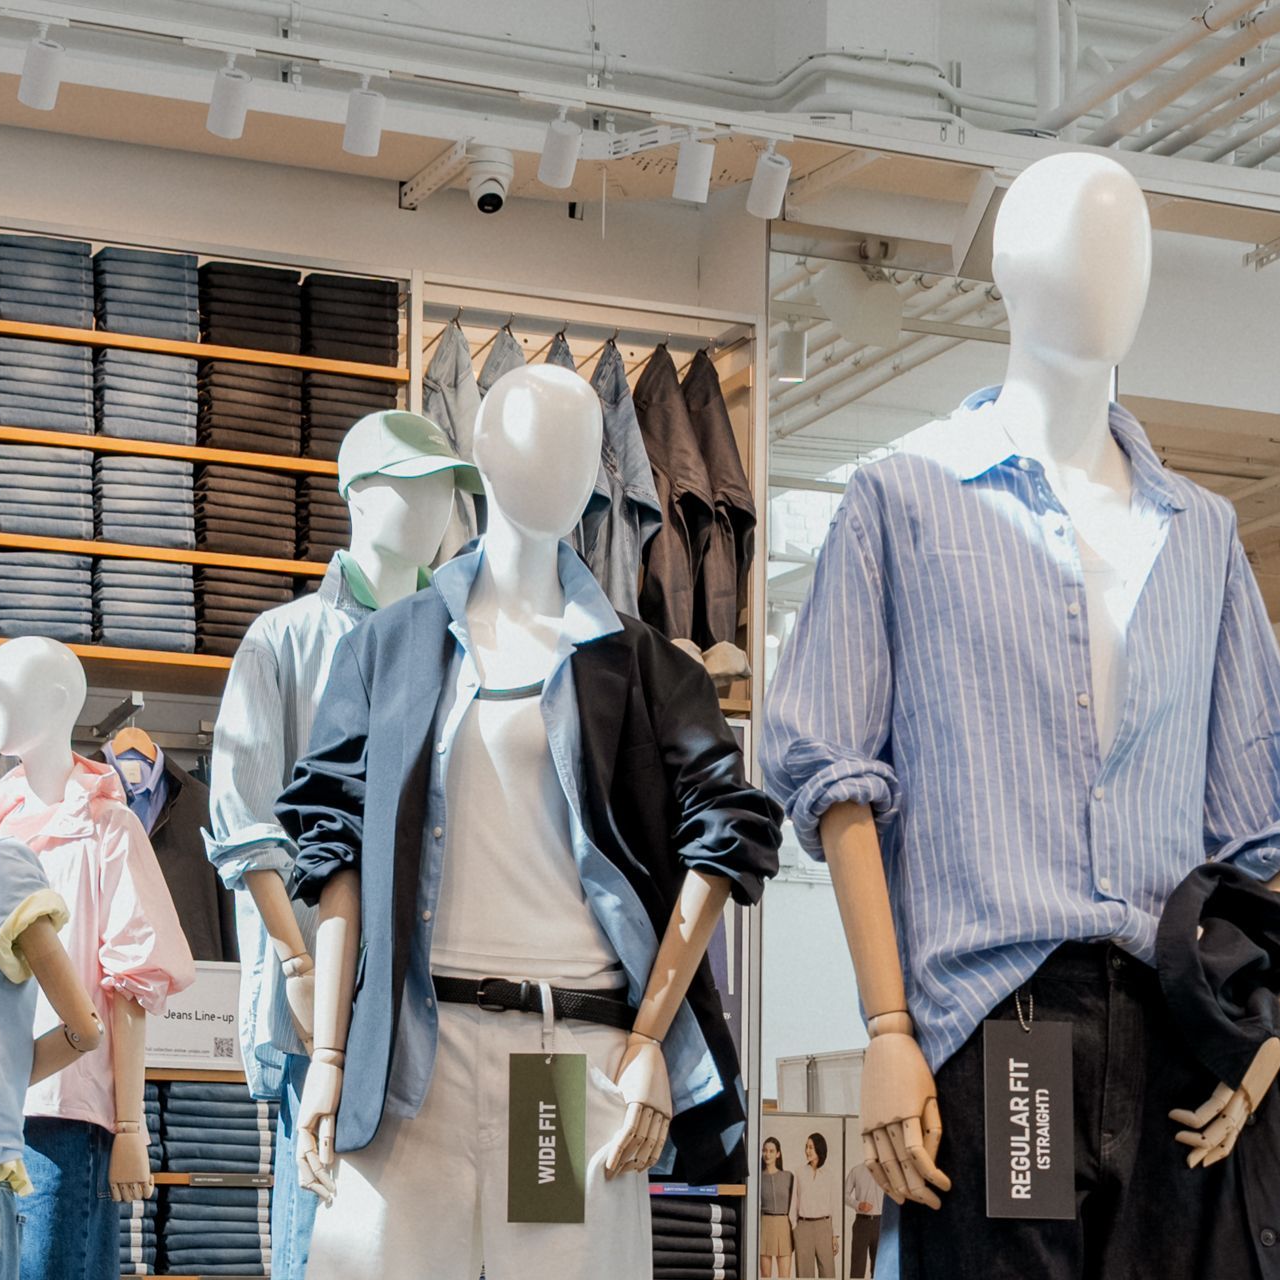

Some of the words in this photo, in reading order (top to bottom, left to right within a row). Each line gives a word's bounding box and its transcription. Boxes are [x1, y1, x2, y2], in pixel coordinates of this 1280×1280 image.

[164, 1008, 193, 1020] Jeans
[195, 1010, 234, 1024] Line-up
[1009, 1057, 1029, 1092] FIT
[538, 1101, 556, 1130] FIT
[1035, 1088, 1051, 1170] (STRAIGHT)
[538, 1135, 556, 1184] WIDE
[1009, 1098, 1031, 1199] REGULAR
